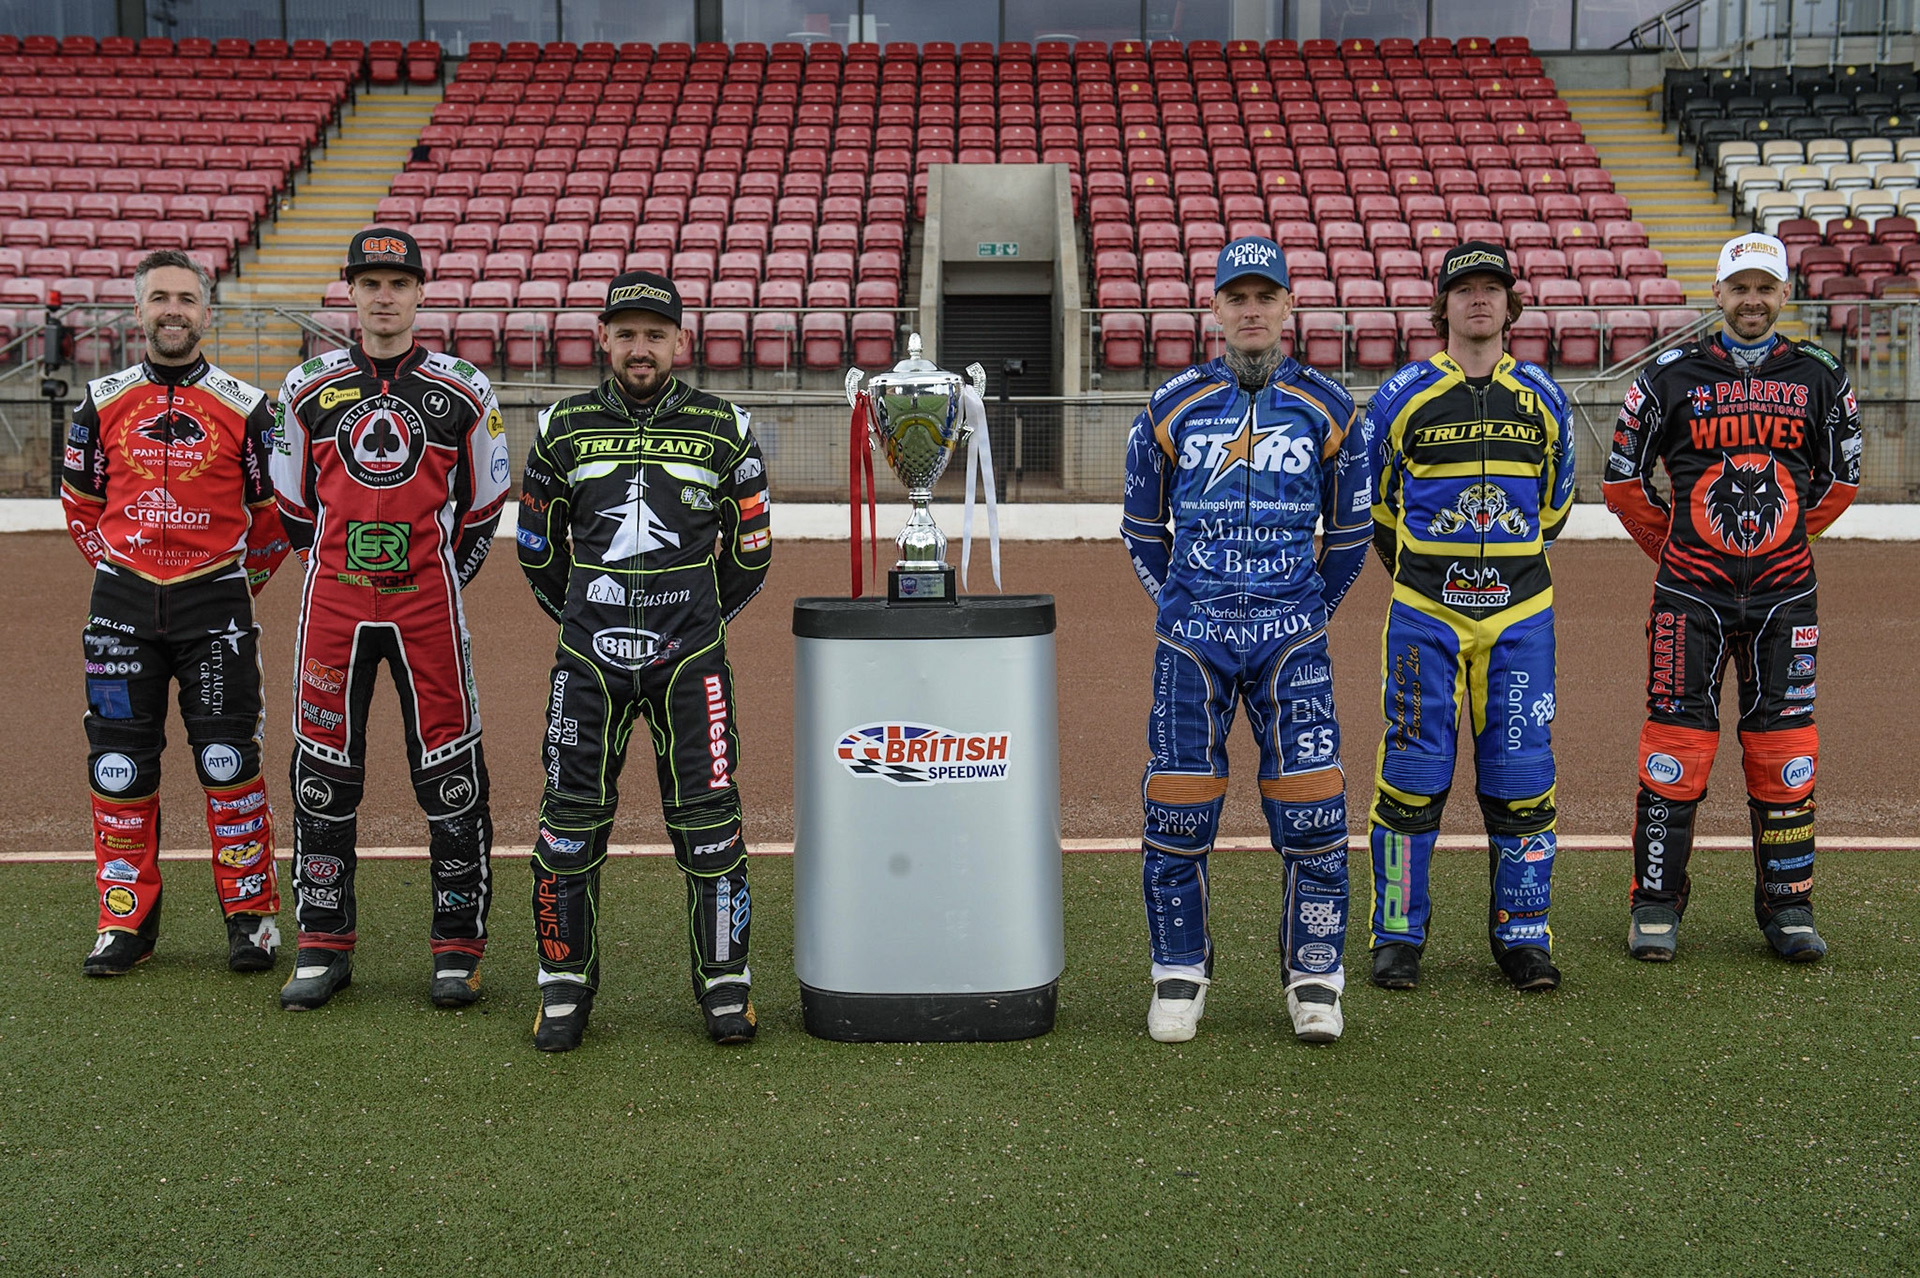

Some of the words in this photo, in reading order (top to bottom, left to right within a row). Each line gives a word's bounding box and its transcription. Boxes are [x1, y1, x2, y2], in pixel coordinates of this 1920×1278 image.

[362, 236, 408, 255] CFS
[1225, 242, 1277, 261] ADRIAN
[1745, 242, 1778, 255] PARRYS
[1233, 252, 1270, 267] FLUX
[94, 371, 137, 398] Crendon
[209, 375, 253, 405] Crendon
[1715, 379, 1809, 407] PARRYS
[429, 395, 445, 412] 4
[1518, 390, 1536, 415] 4
[1717, 402, 1807, 418] INTERNATIONAL
[341, 403, 372, 433] BELLE
[400, 409, 422, 435] ACES
[1184, 418, 1211, 428] KING'S
[1213, 416, 1240, 426] LYNN
[1423, 425, 1466, 442] TRU
[1469, 424, 1541, 441] PLANT
[1689, 413, 1805, 450] WOLVES
[132, 447, 203, 461] PANTHERS
[579, 438, 623, 455] TRU
[626, 438, 707, 456] PLANT
[359, 471, 404, 482] MANCHESTER
[124, 504, 211, 525] Crendon
[140, 521, 159, 529] TIMBER
[161, 521, 209, 531] ENGINEERING
[1197, 517, 1293, 542] Minors
[142, 546, 164, 558] CITY
[164, 547, 211, 558] AUCTION
[1187, 540, 1216, 570] &
[1223, 548, 1303, 580] Brady
[157, 557, 191, 568] GROUP
[1250, 607, 1282, 619] Cabin
[92, 616, 136, 635] STELLAR
[1171, 619, 1258, 645] ADRIAN
[1262, 612, 1313, 641] FLUX
[1795, 627, 1818, 641] NGK
[601, 637, 658, 659] BALL
[1652, 611, 1675, 696] PARRYS
[1674, 613, 1687, 697] INTERNATIONAL
[1406, 643, 1420, 676] Ltd
[1158, 653, 1172, 696] Brady
[1394, 654, 1405, 685] Car
[200, 661, 211, 705] GROUP
[302, 701, 319, 717] BLUE
[320, 705, 344, 724] DOOR
[548, 671, 569, 743] WELDING
[1153, 699, 1167, 717] &
[1406, 681, 1421, 740] Services
[1508, 670, 1530, 751] PlanCon
[304, 711, 337, 731] PROJECT
[561, 717, 578, 746] Ltd
[704, 676, 731, 788] milesey
[885, 735, 1008, 764] BRITISH
[1158, 720, 1170, 769] Minors
[208, 756, 233, 768] ATPI
[927, 763, 1008, 780] SPEEDWAY
[1651, 761, 1675, 777] ATPI
[101, 766, 128, 779] ATPI
[1789, 766, 1810, 781] ATPI
[302, 785, 328, 804] ATPI
[445, 782, 470, 801] ATPI
[1148, 805, 1210, 826] ADRIAN
[1284, 806, 1344, 831] Elite
[1157, 822, 1198, 839] FLUX
[310, 862, 334, 877] STS
[1151, 866, 1164, 913] NORFOLK
[1300, 900, 1336, 915] east
[1513, 897, 1525, 907] &
[558, 900, 569, 938] CLIMATE
[1307, 923, 1340, 938] signs
[1304, 952, 1331, 962] STS
